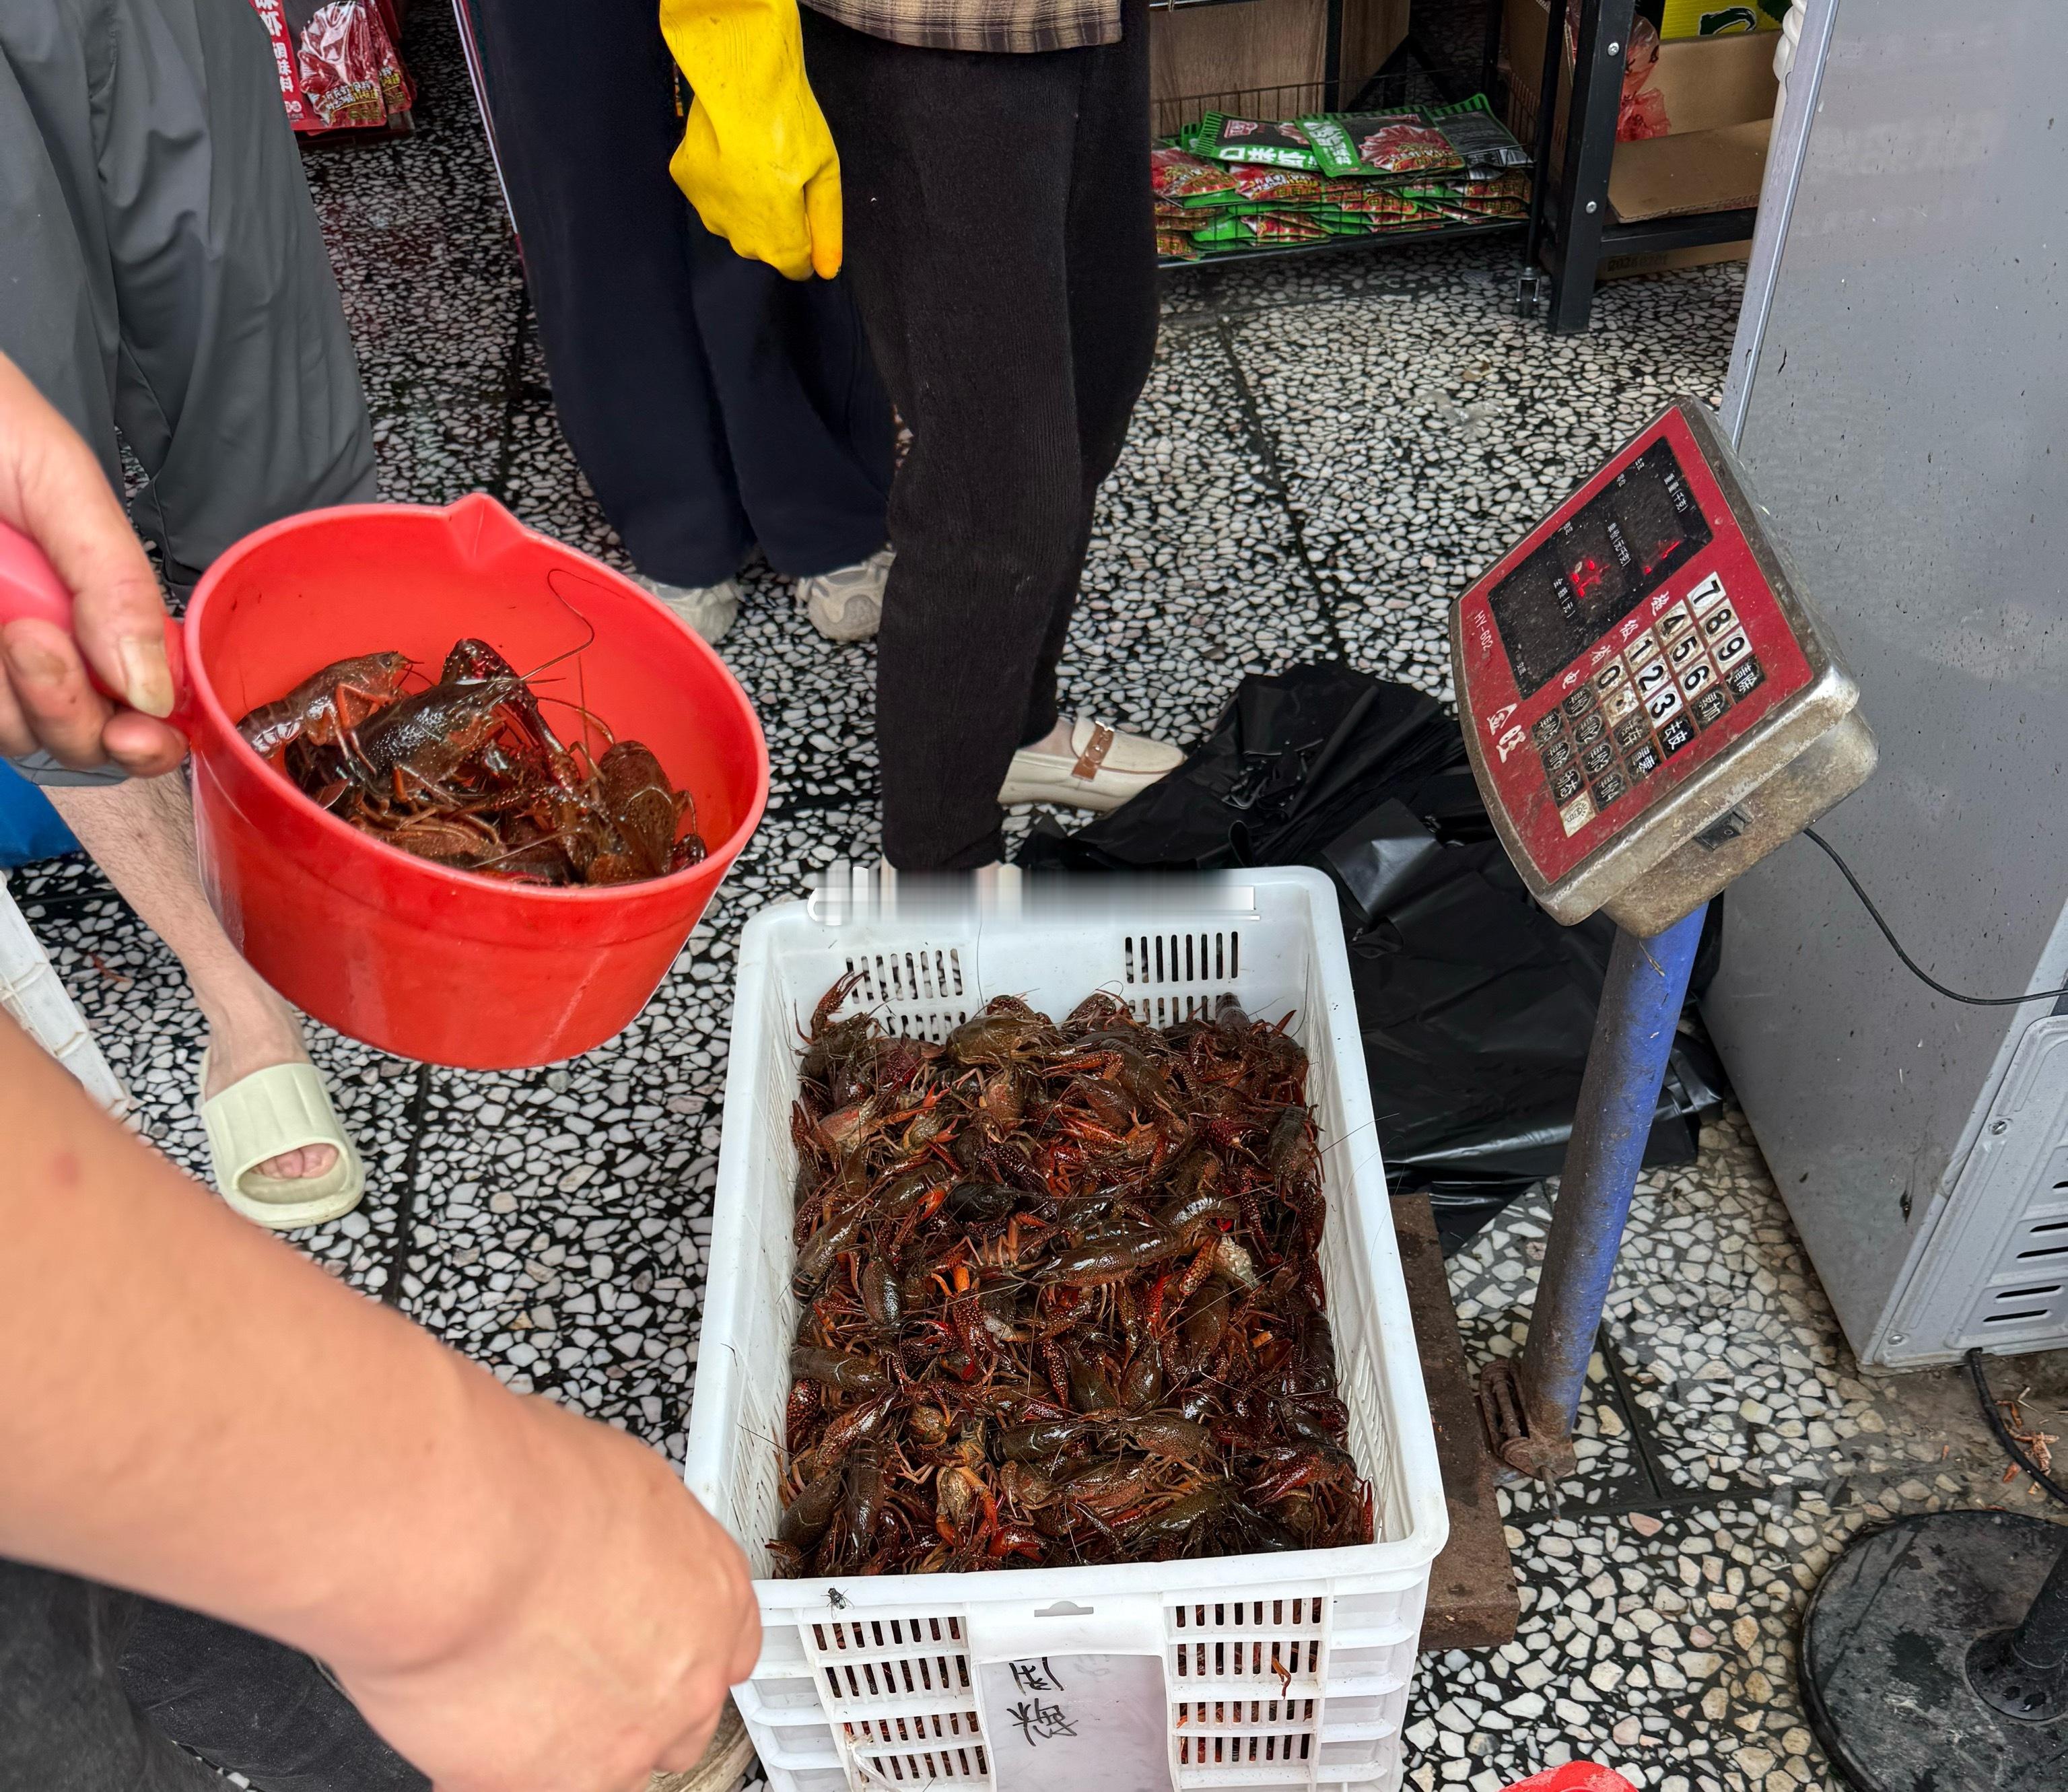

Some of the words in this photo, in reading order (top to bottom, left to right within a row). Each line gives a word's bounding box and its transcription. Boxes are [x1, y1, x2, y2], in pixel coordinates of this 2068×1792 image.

[1693, 579, 1721, 605] 7
[1474, 610, 1493, 652] HY-602
[1662, 614, 1687, 635] 4
[1704, 609, 1732, 635] 8
[1628, 638, 1653, 663] 1
[1672, 635, 1698, 662] 5
[1717, 636, 1745, 662] 9
[1596, 664, 1621, 690] 0
[1638, 664, 1664, 693] 2
[1684, 665, 1710, 691] 6
[1730, 662, 1758, 693] 清除
[1650, 693, 1676, 720] 3
[1664, 720, 1688, 751] 去皮
